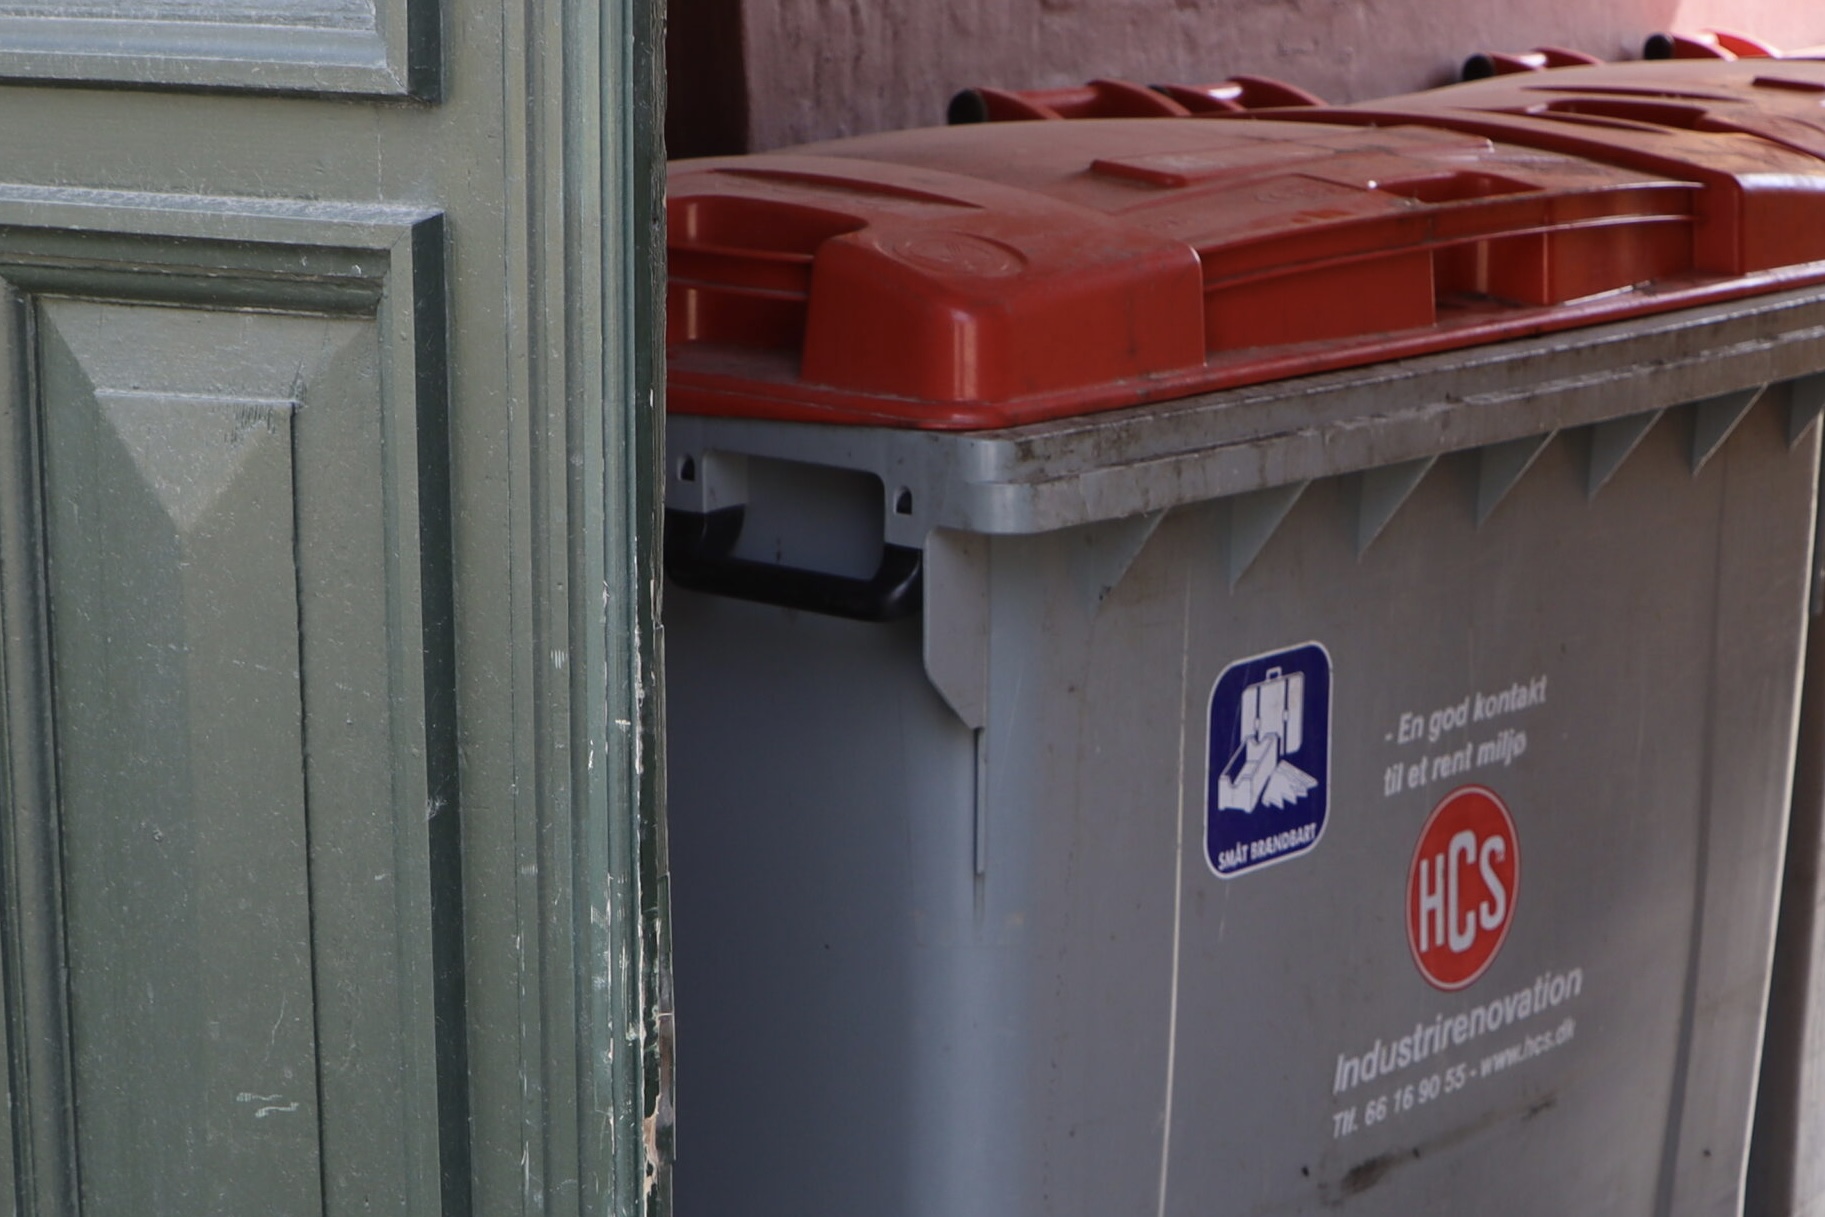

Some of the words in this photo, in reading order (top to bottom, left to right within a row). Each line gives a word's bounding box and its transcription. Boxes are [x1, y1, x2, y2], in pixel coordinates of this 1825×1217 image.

[1397, 711, 1425, 745] En
[1428, 695, 1470, 742] god
[1473, 674, 1547, 722] kontakt
[1384, 762, 1404, 797] til
[1407, 756, 1428, 788] et
[1431, 742, 1473, 782] rent
[1218, 841, 1249, 871] SMÅT
[1251, 822, 1317, 860] BRÆNDBART
[1417, 829, 1507, 955] HCS
[1333, 966, 1584, 1095] Industrirenovation
[1333, 1102, 1358, 1139] Tlf.
[1364, 1096, 1388, 1127] 66
[1393, 1085, 1414, 1113] 16
[1417, 1074, 1441, 1104] 90
[1444, 1063, 1467, 1093] 55
[1480, 1016, 1576, 1079] www.hcs.dk
